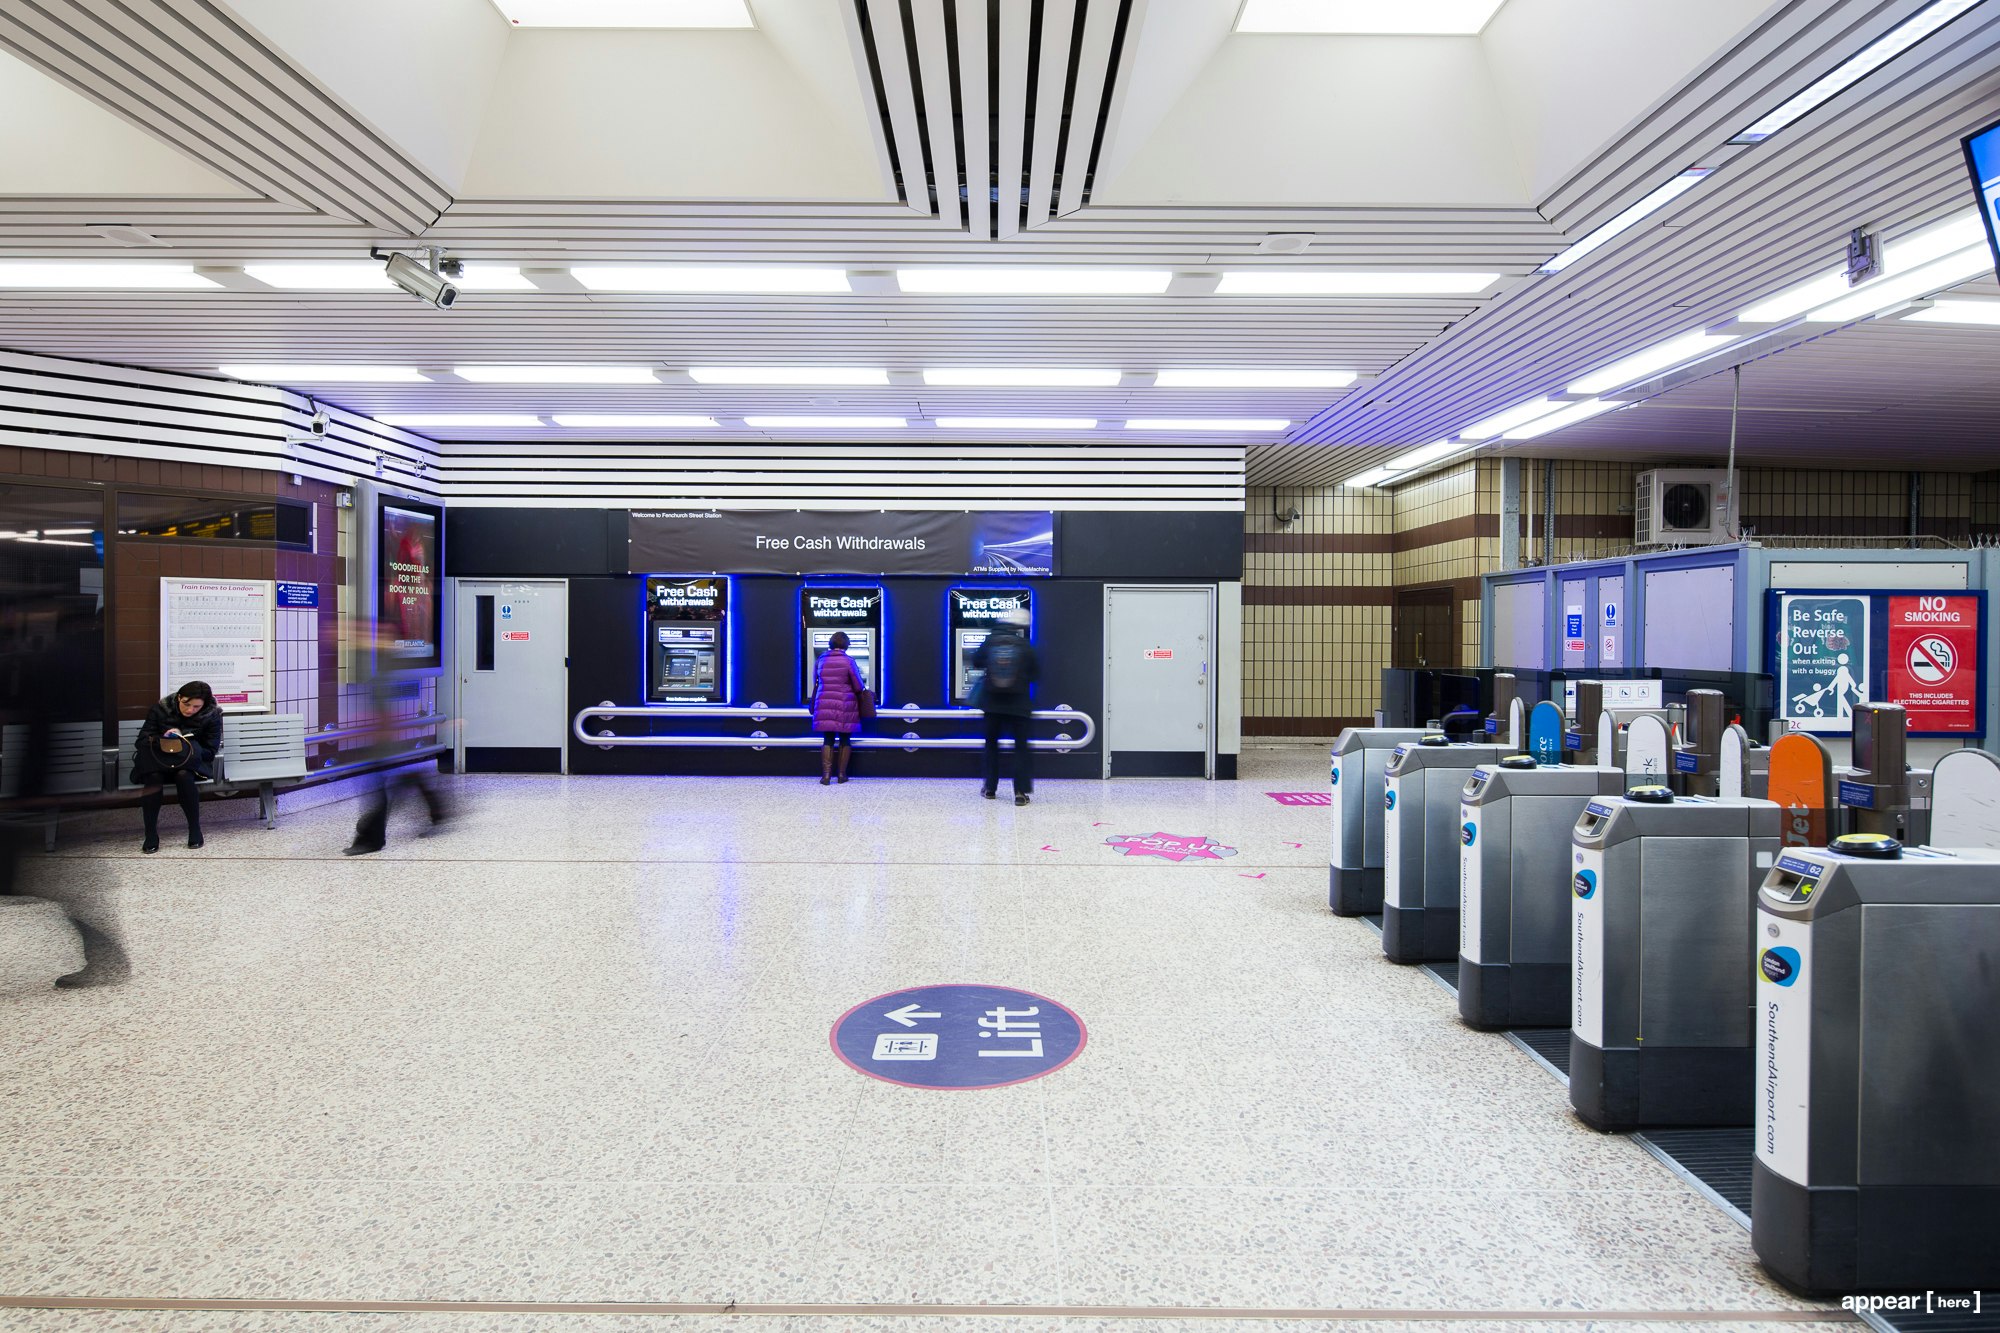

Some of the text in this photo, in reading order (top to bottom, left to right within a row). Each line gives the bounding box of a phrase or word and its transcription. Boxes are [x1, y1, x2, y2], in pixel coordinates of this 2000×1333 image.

[756, 535, 926, 550] Free Cash Withdrawals
[398, 574, 421, 584] FOR THE
[389, 584, 407, 594] ROCK
[416, 586, 429, 595] ROLL
[656, 585, 718, 597] Free Cash
[659, 597, 714, 606] withdrawals
[810, 596, 872, 608] Free Cash
[959, 597, 1021, 609] Free Cash
[1919, 596, 1947, 612] NO
[813, 608, 867, 617] withdrawals
[962, 609, 1012, 618] withdrawal
[1793, 609, 1844, 621] Be Safe
[1904, 612, 1960, 622] SMOKING
[1793, 627, 1844, 638] Reverse
[1793, 643, 1818, 654] Out
[1812, 658, 1836, 666] exiting
[1815, 667, 1836, 676] buggy
[1791, 720, 1801, 729] 2c
[1538, 736, 1547, 764] oice
[1124, 837, 1181, 847] POP
[1185, 842, 1227, 851] UP
[1810, 865, 1822, 875] 62
[1764, 955, 1780, 966] London
[1764, 961, 1786, 975] Southend
[978, 1006, 1044, 1057] Lift
[1766, 1001, 1779, 1155] SouthendAirport.com
